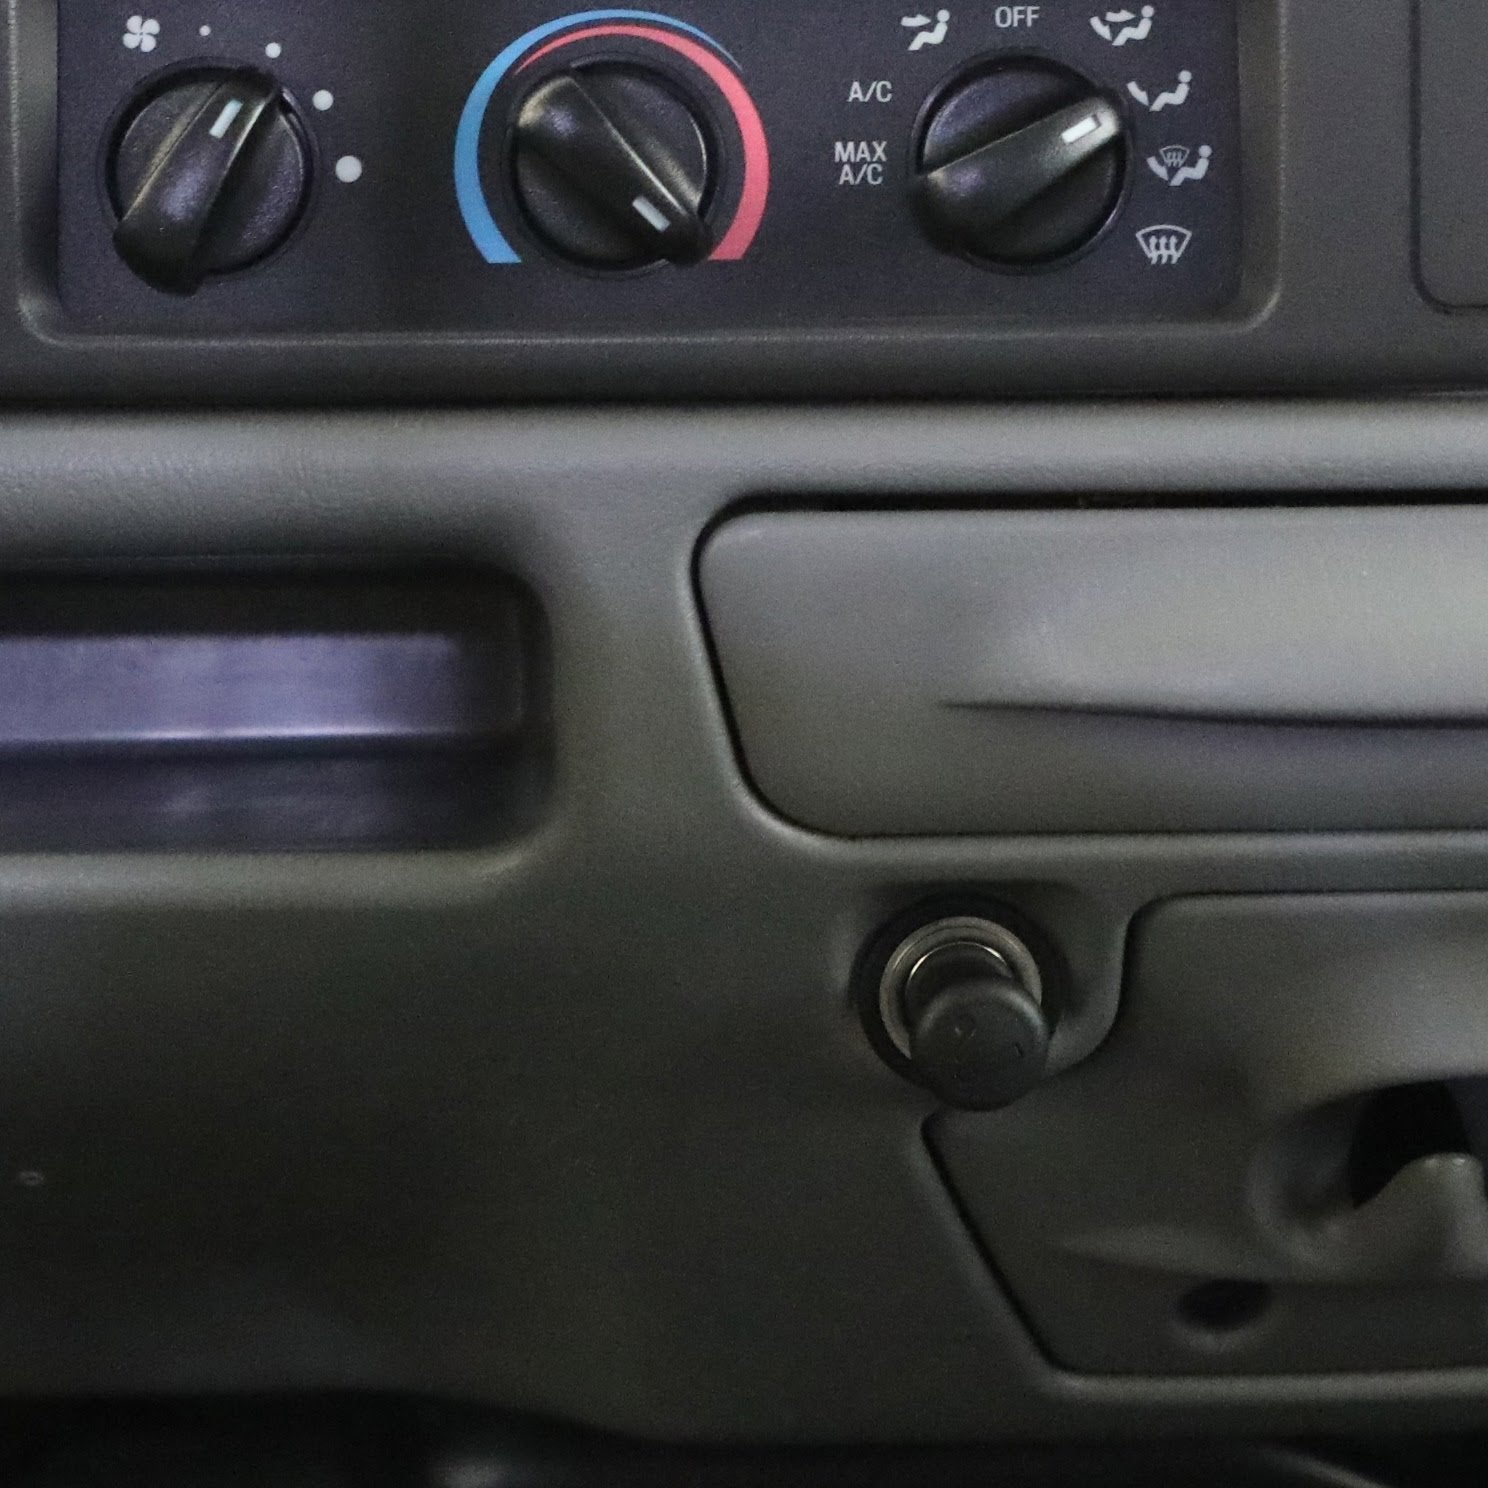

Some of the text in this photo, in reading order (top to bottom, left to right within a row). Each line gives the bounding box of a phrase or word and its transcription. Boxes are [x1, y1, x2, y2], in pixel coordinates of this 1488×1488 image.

[994, 6, 1040, 28] OFF
[848, 81, 892, 103] A/C
[834, 141, 887, 163] MAX
[839, 163, 883, 186] A/C
